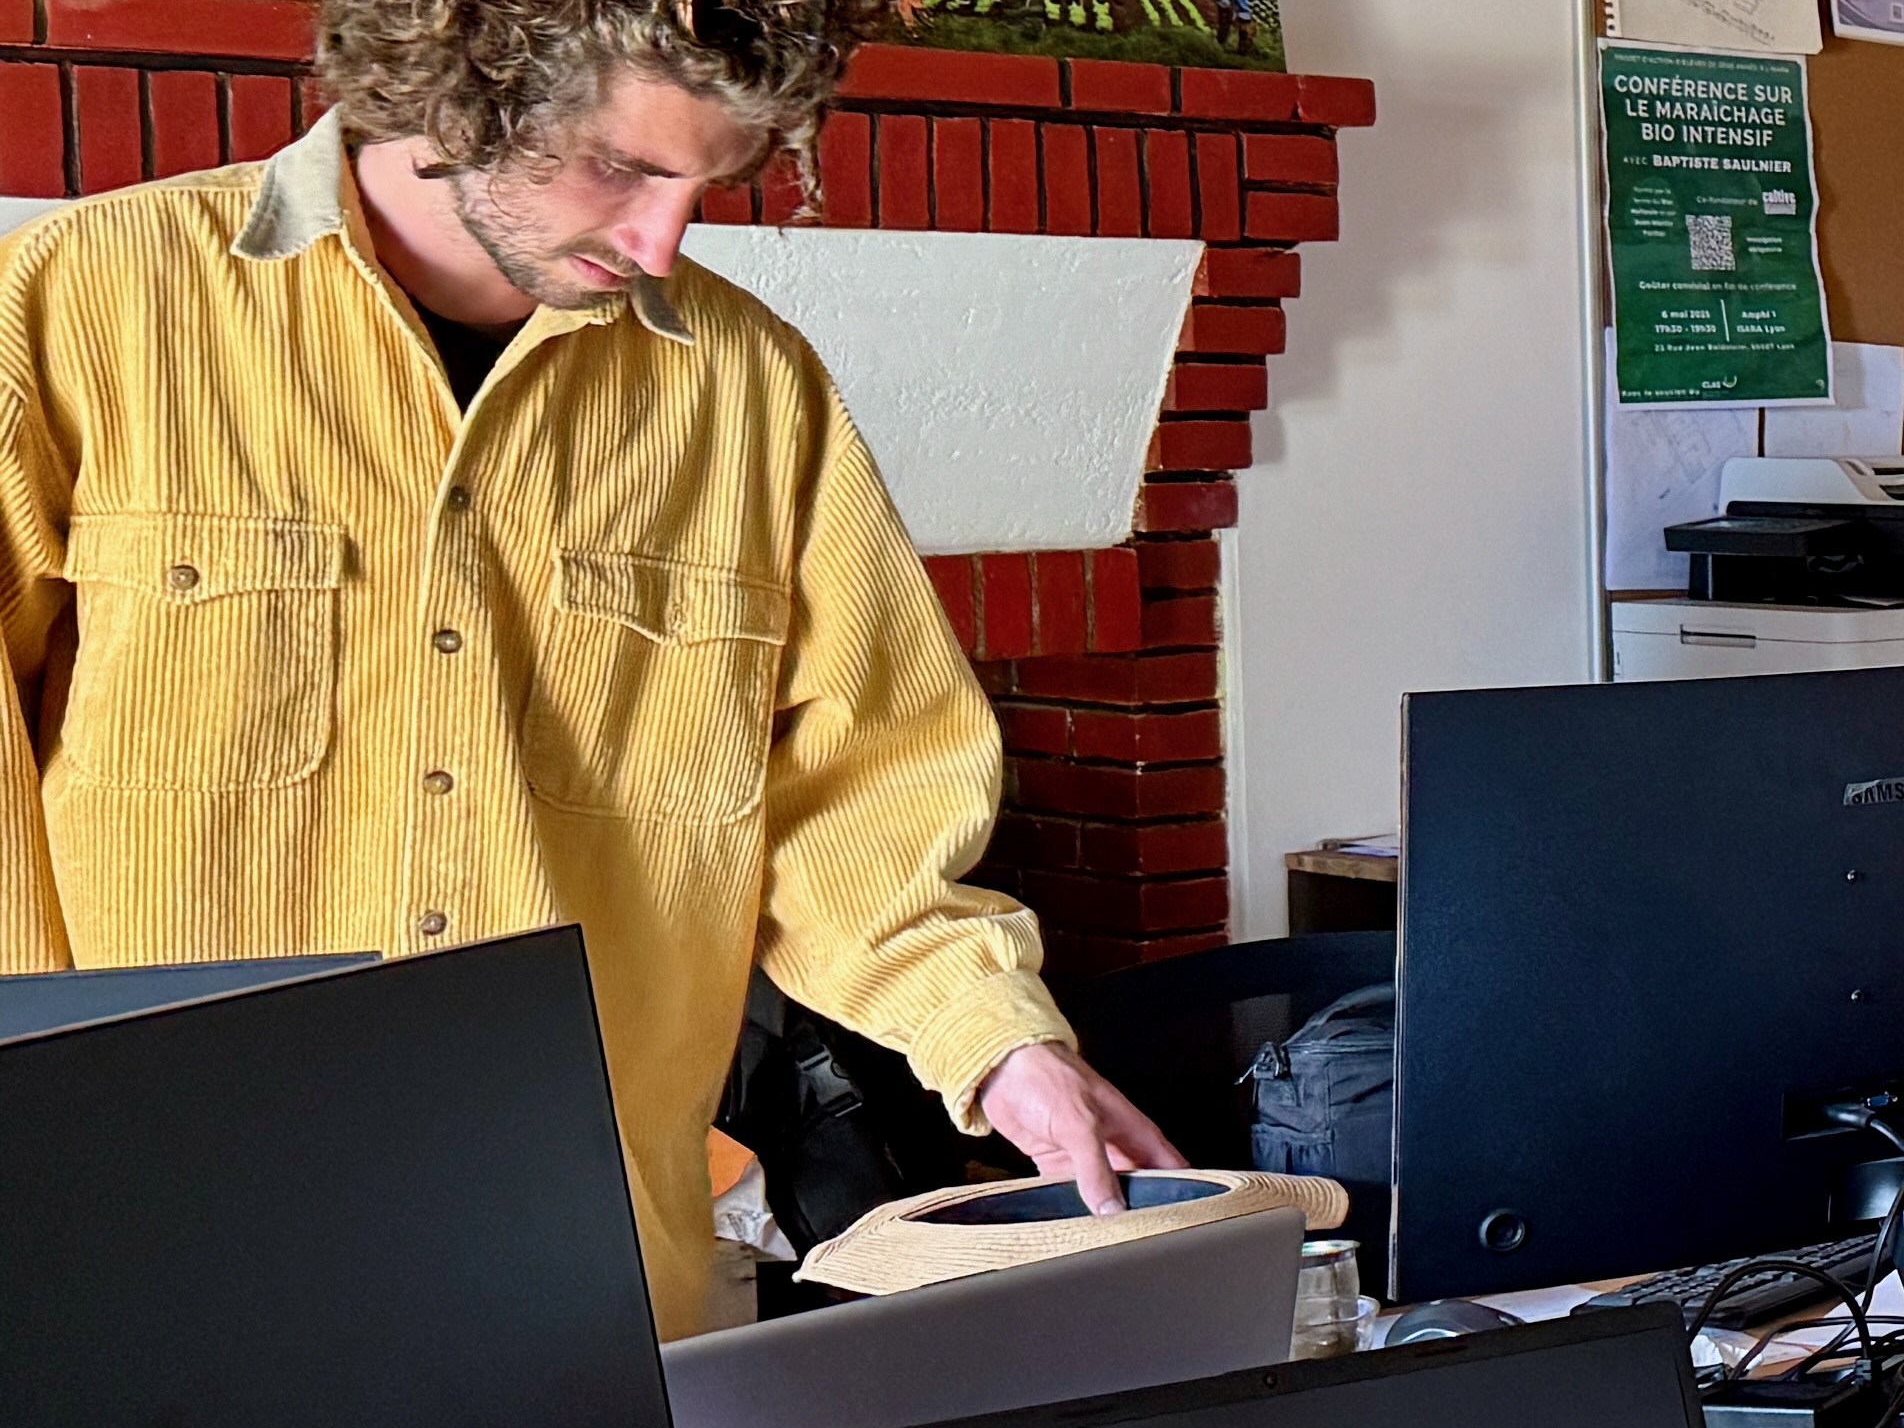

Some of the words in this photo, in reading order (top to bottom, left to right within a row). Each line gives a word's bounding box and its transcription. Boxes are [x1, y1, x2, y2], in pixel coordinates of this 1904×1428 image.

[1614, 75, 1748, 101] CONFÉRENCE
[1754, 84, 1793, 104] SUR
[1625, 99, 1649, 117] LE
[1656, 100, 1786, 126] MARAÎCHAGE
[1641, 123, 1675, 142] BIO
[1682, 125, 1773, 147] INTENSIF
[1623, 155, 1648, 166] AVEC
[1652, 154, 1719, 170] BAPTISTE
[1723, 158, 1792, 173] SAULNIER
